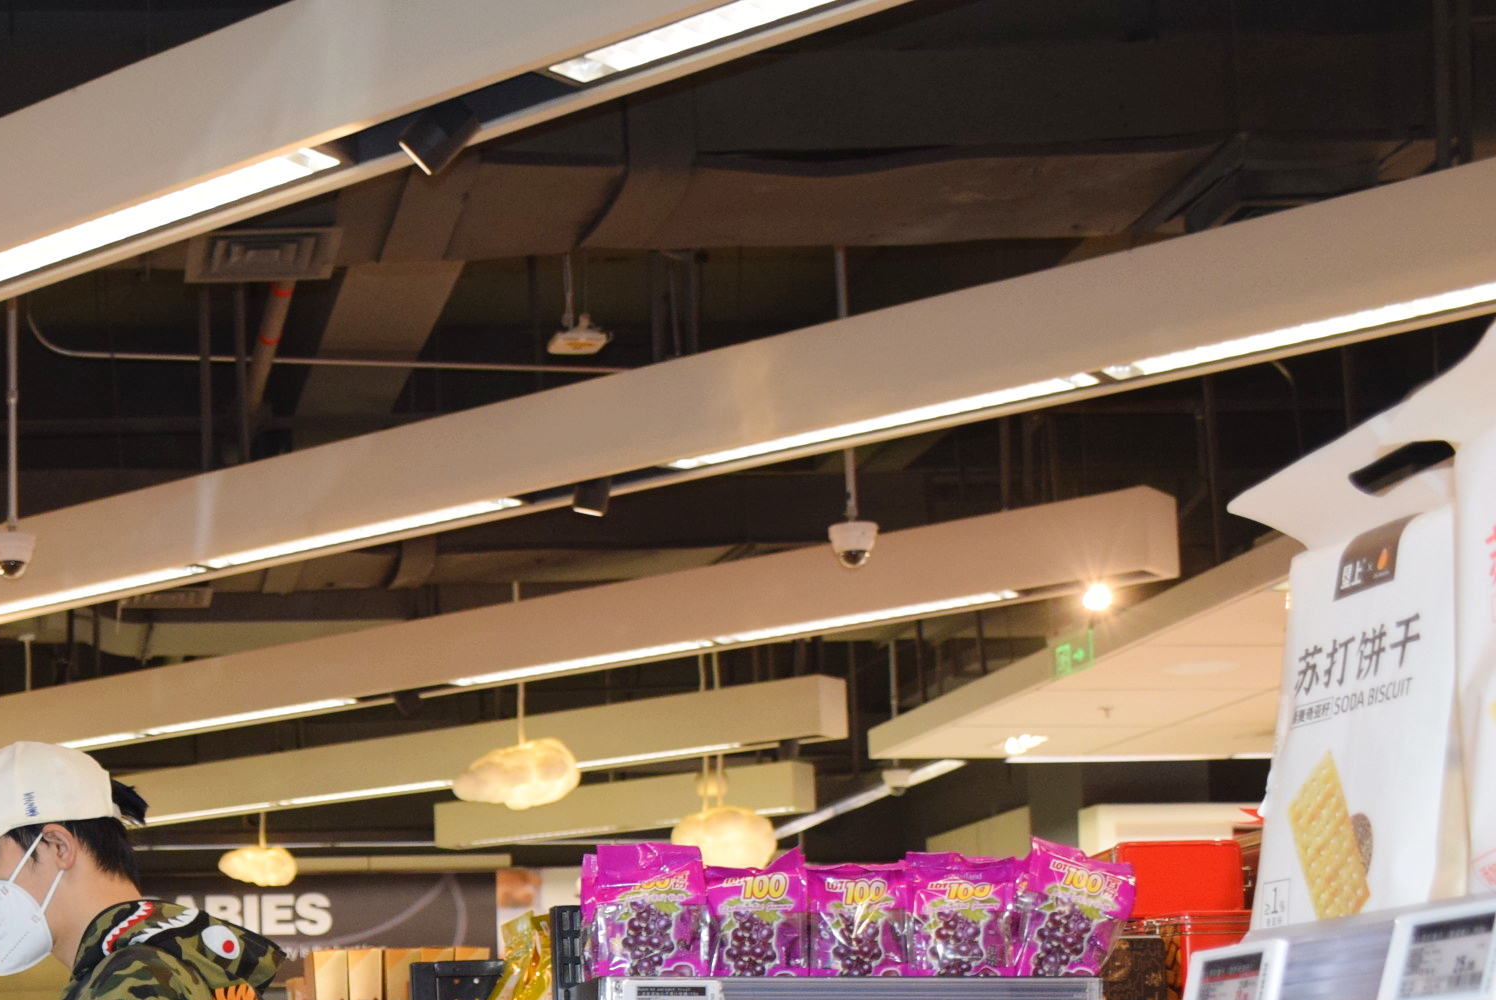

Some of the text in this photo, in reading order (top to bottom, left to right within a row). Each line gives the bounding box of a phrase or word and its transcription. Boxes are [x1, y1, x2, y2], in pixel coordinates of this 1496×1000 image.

[1294, 612, 1421, 698] 苏打饼干
[1334, 677, 1413, 716] SODA BISCUIT
[742, 872, 789, 899] 100
[844, 879, 887, 905] 100
[947, 881, 993, 900] 100
[1064, 866, 1105, 892] 100
[165, 891, 334, 936] ABIES
